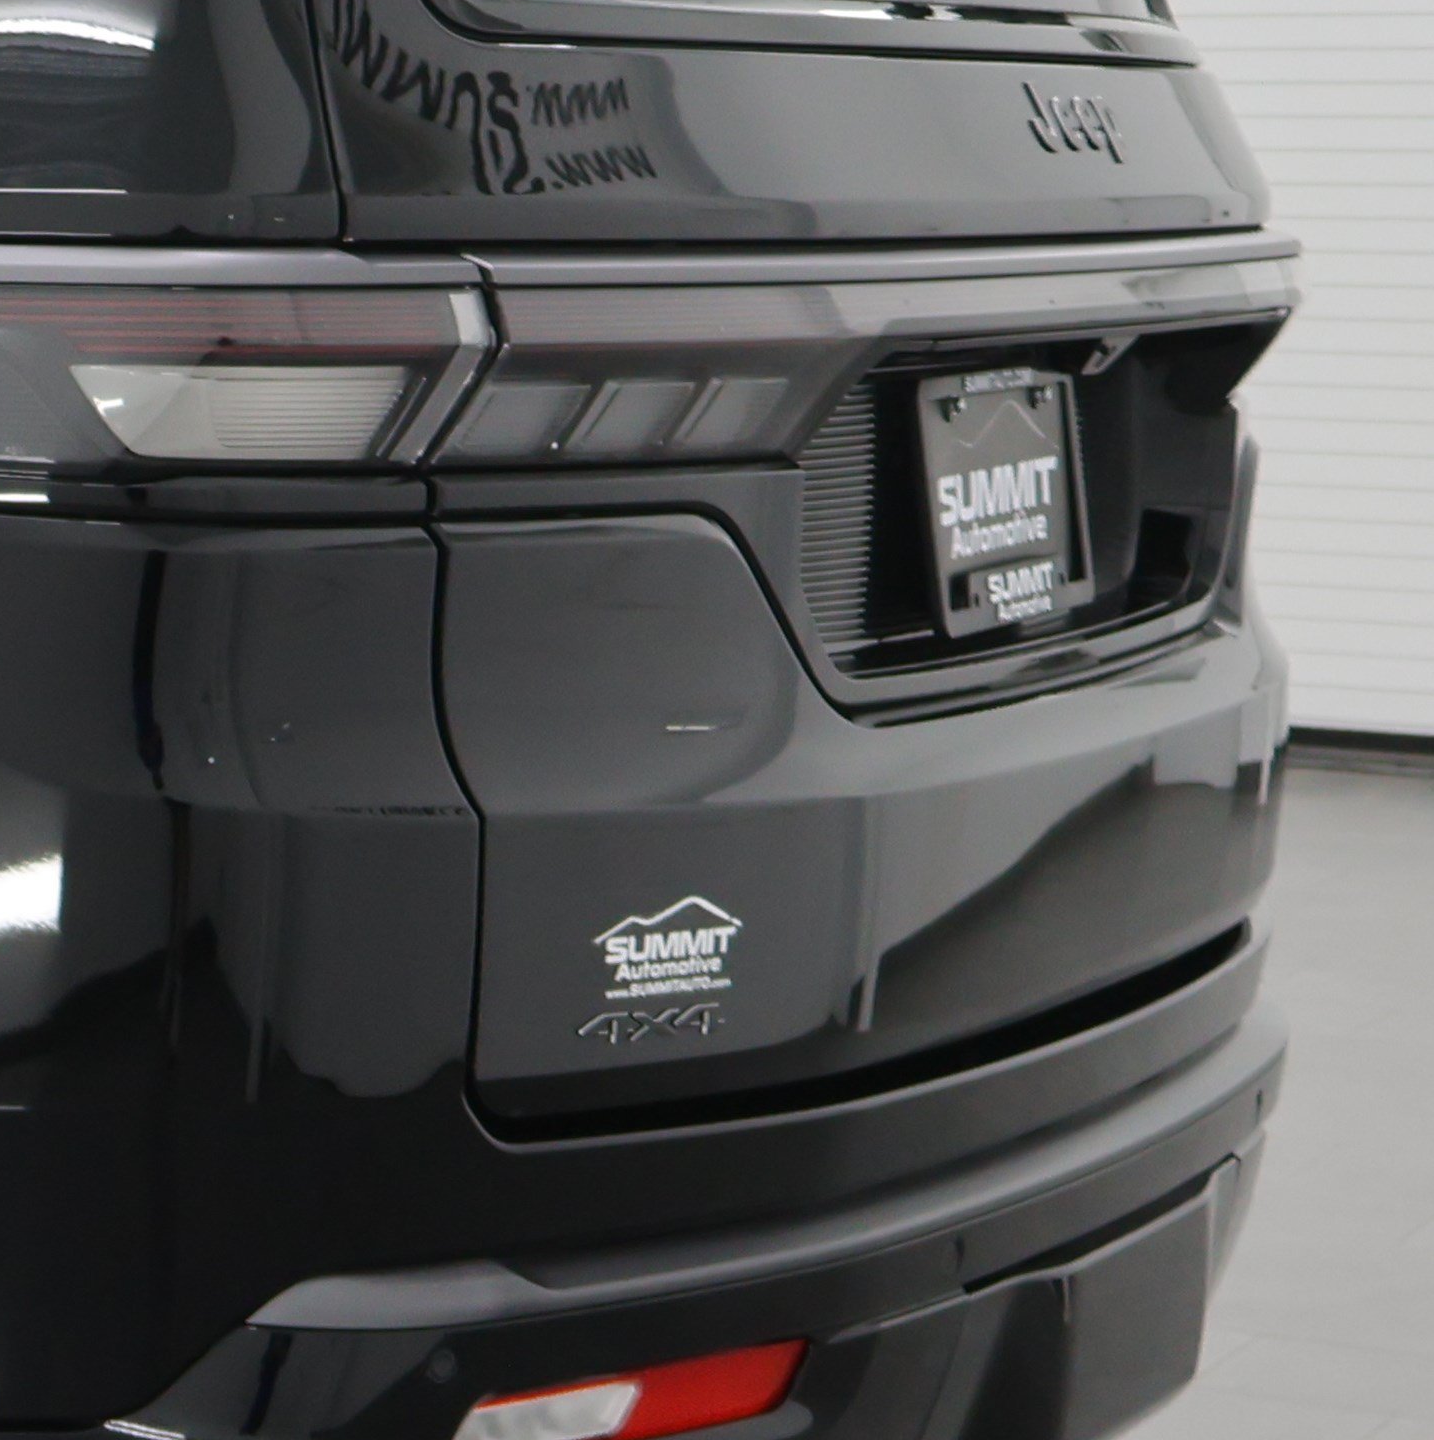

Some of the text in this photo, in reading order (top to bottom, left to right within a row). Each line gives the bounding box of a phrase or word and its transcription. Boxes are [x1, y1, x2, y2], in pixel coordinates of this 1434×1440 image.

[1020, 81, 1125, 165] Jeep
[937, 455, 1059, 527] SUMMIT
[950, 512, 1048, 560] Automotive
[987, 561, 1054, 605] SUMMIT
[604, 925, 738, 965] SUMMIT
[613, 955, 723, 982] Automotive
